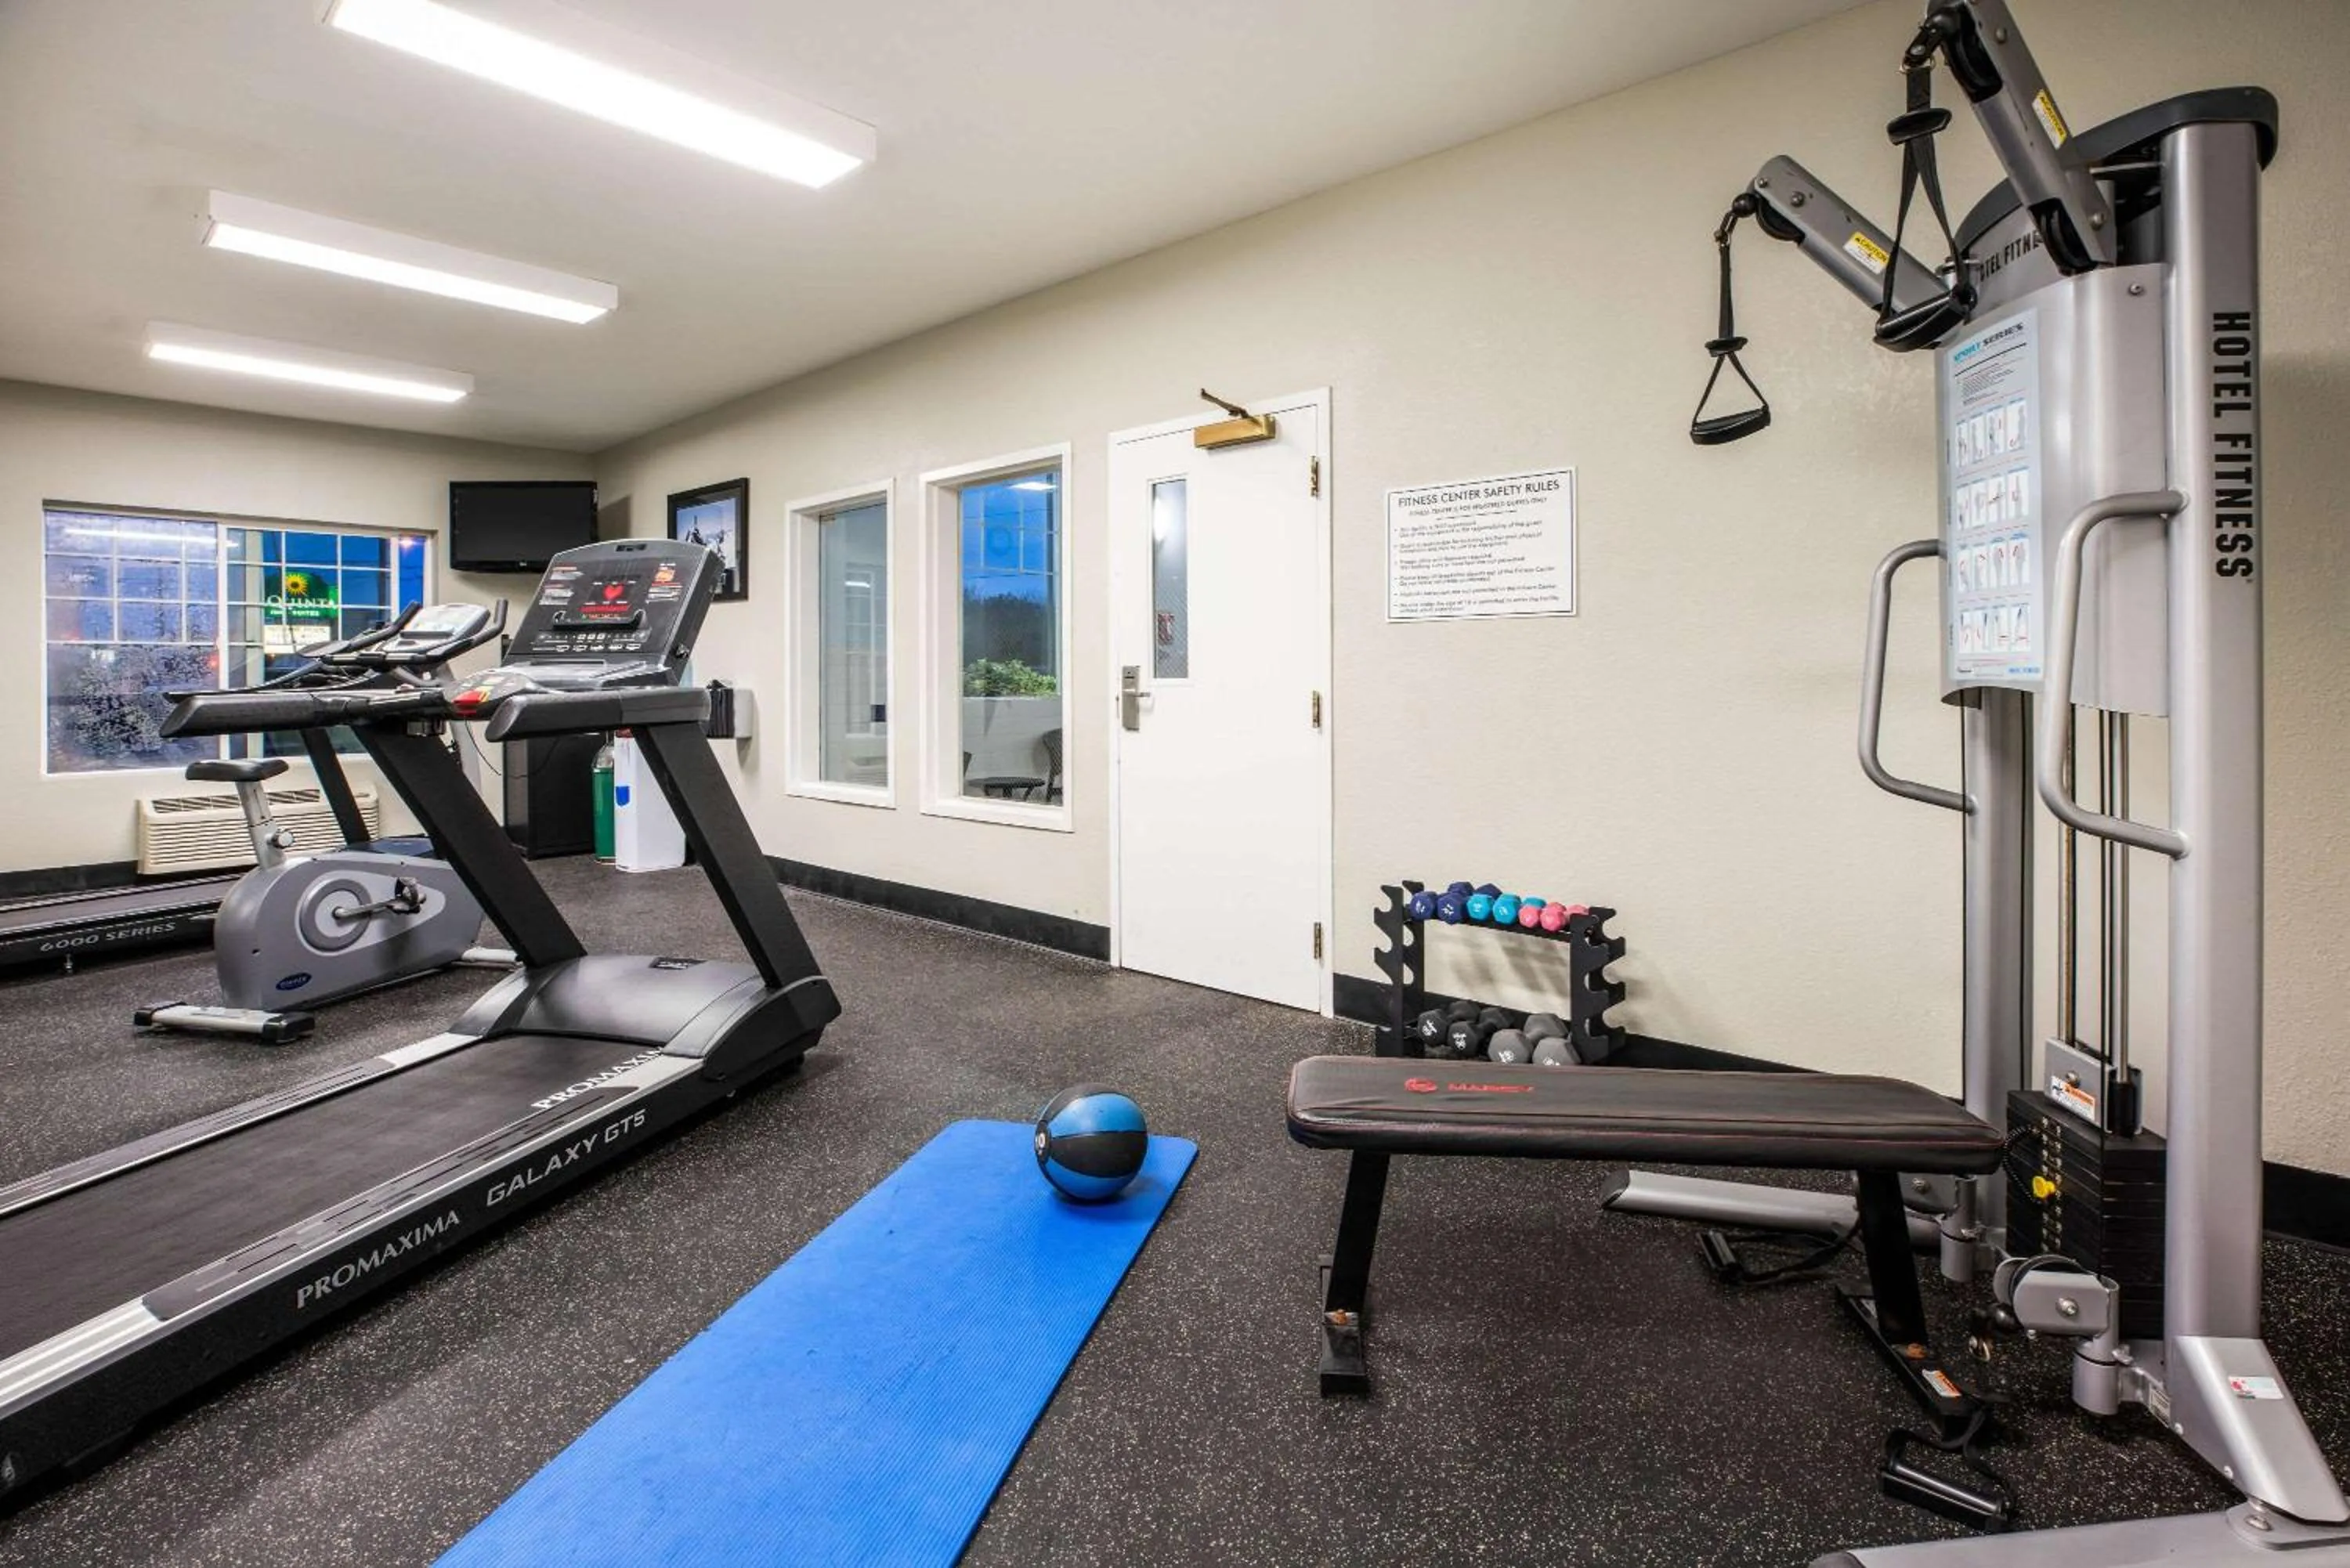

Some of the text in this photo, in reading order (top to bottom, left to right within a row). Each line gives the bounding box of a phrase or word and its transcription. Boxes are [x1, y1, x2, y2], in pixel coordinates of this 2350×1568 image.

[1979, 229, 2040, 282] OTEL FITNE
[2213, 312, 2254, 577] HOTEL FITNESS
[1398, 479, 1560, 508] FITNESS CENTER SAFETY RULES
[40, 922, 176, 952] 6000 SERIES
[531, 1046, 664, 1109] PROMAXI
[296, 1108, 646, 1310] PROMAXIMA GALAXY GT5
